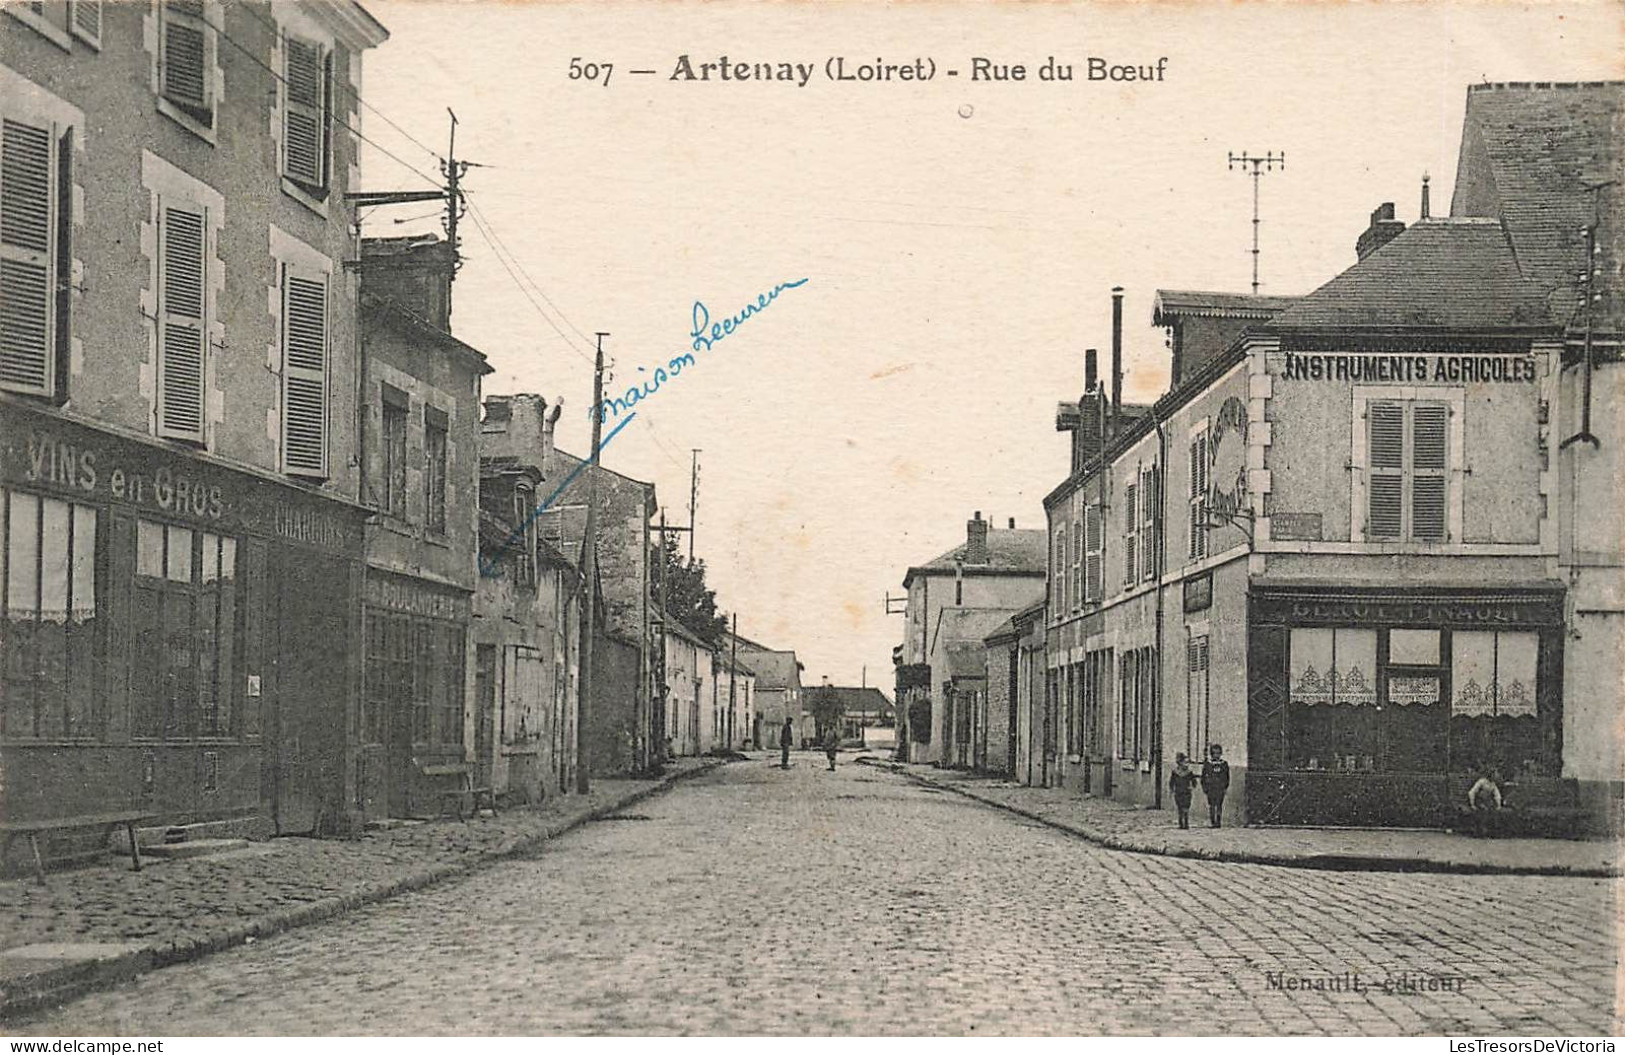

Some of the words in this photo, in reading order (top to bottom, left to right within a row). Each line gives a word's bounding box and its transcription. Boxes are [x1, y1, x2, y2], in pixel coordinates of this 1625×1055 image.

[1282, 352, 1428, 383] INSTRUMENTS
[1434, 355, 1536, 384] AGRICOLES
[25, 434, 97, 493] VINS
[111, 467, 143, 502] en
